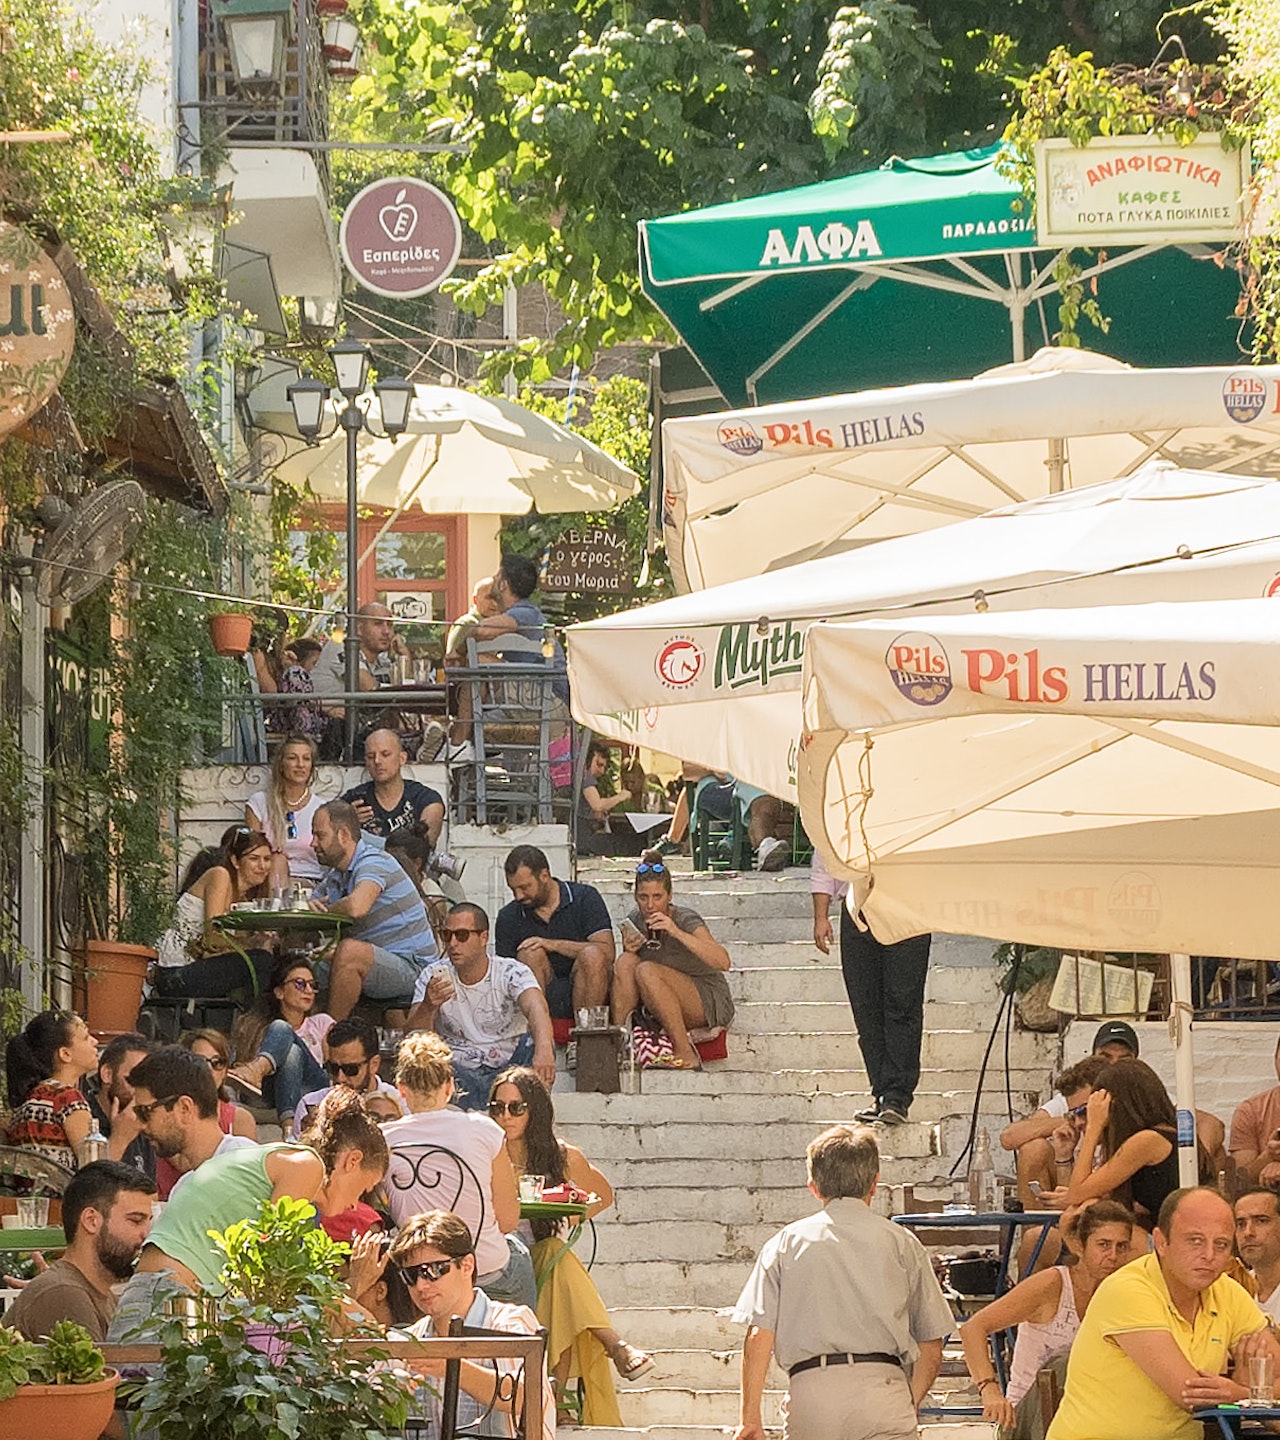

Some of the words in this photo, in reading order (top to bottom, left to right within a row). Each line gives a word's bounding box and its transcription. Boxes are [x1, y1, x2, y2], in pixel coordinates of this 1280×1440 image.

[1086, 155, 1221, 187] ΑΝΑΦΙΩΤΙΚΑ
[1118, 191, 1181, 205] ΚΑΦΕΣ
[1078, 211, 1114, 224] ΠΟΤΑ
[1119, 210, 1163, 222] ΓΛΥΚΑ
[1167, 207, 1231, 221] ΠΟΙΚΙΛΙΕΣ
[759, 219, 882, 265] ΑΛΦΑ
[363, 246, 441, 264] Εσπερίδες
[1230, 378, 1264, 394] Pils
[1226, 394, 1263, 408] HELLAS
[721, 425, 753, 442] Pils
[762, 419, 833, 448] Pils
[839, 411, 925, 448] HELLAS
[558, 529, 627, 552] ΑΒΕΡΝΑ
[714, 621, 804, 689] Myth
[892, 645, 945, 673] Pils
[960, 648, 1070, 703] Pils
[1082, 660, 1217, 703] HELLAS
